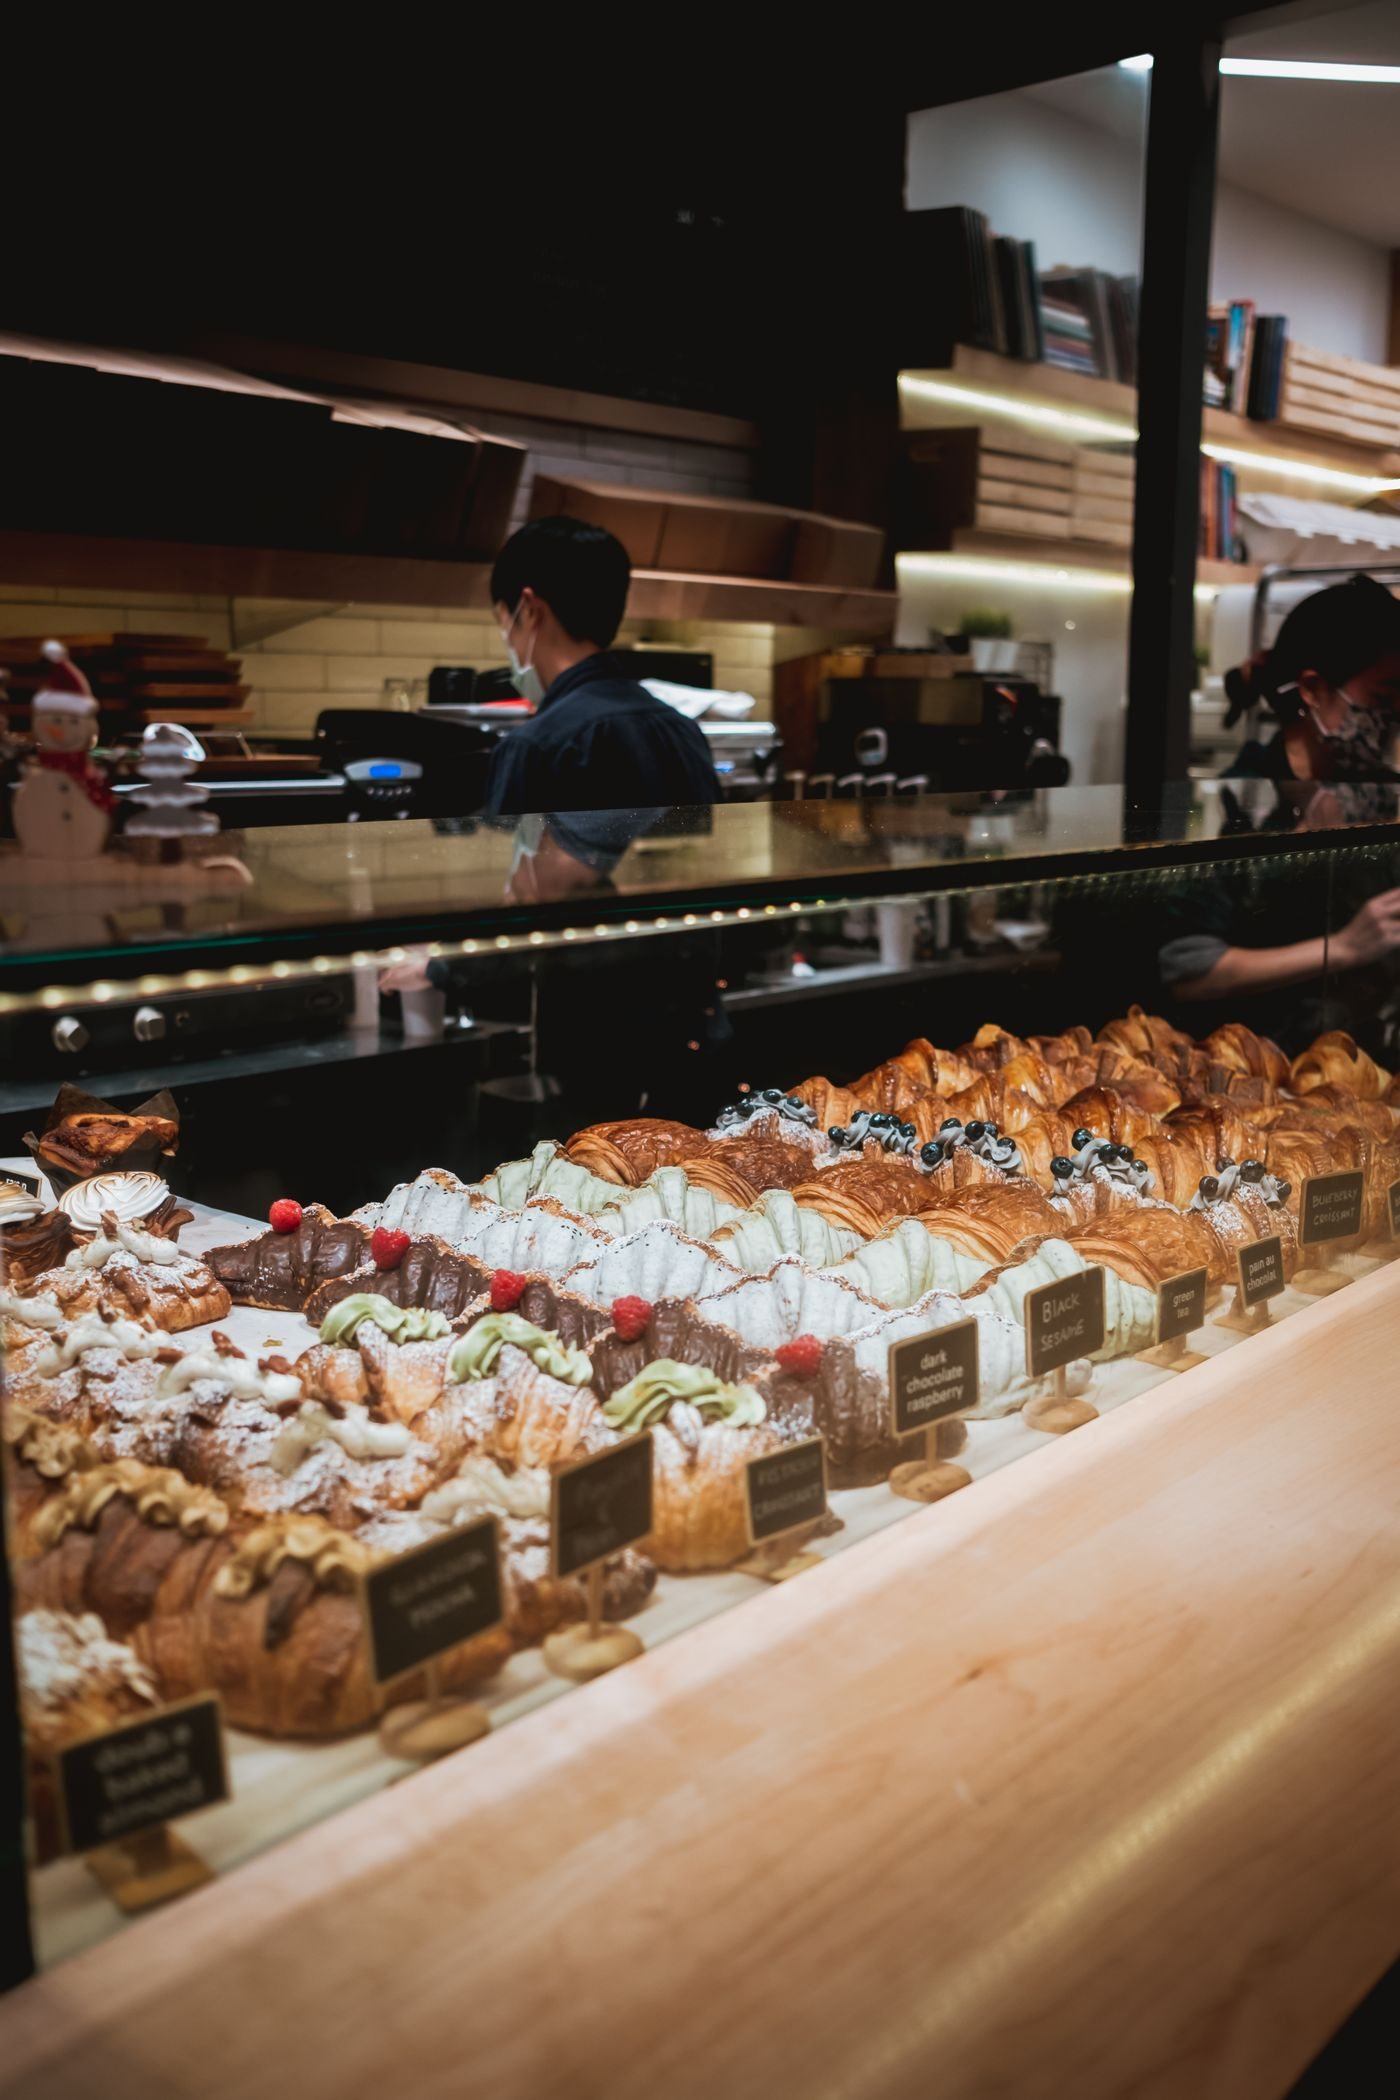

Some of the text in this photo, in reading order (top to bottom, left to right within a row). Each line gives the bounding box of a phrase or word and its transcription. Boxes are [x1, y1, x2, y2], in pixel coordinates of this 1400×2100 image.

[1249, 1255, 1275, 1276] pain au
[1247, 1270, 1276, 1291] chocolat
[1173, 1290, 1195, 1307] green
[1177, 1307, 1189, 1319] tea
[920, 1350, 947, 1370] dark
[906, 1366, 963, 1394] chocolate
[906, 1386, 964, 1412] raspberry
